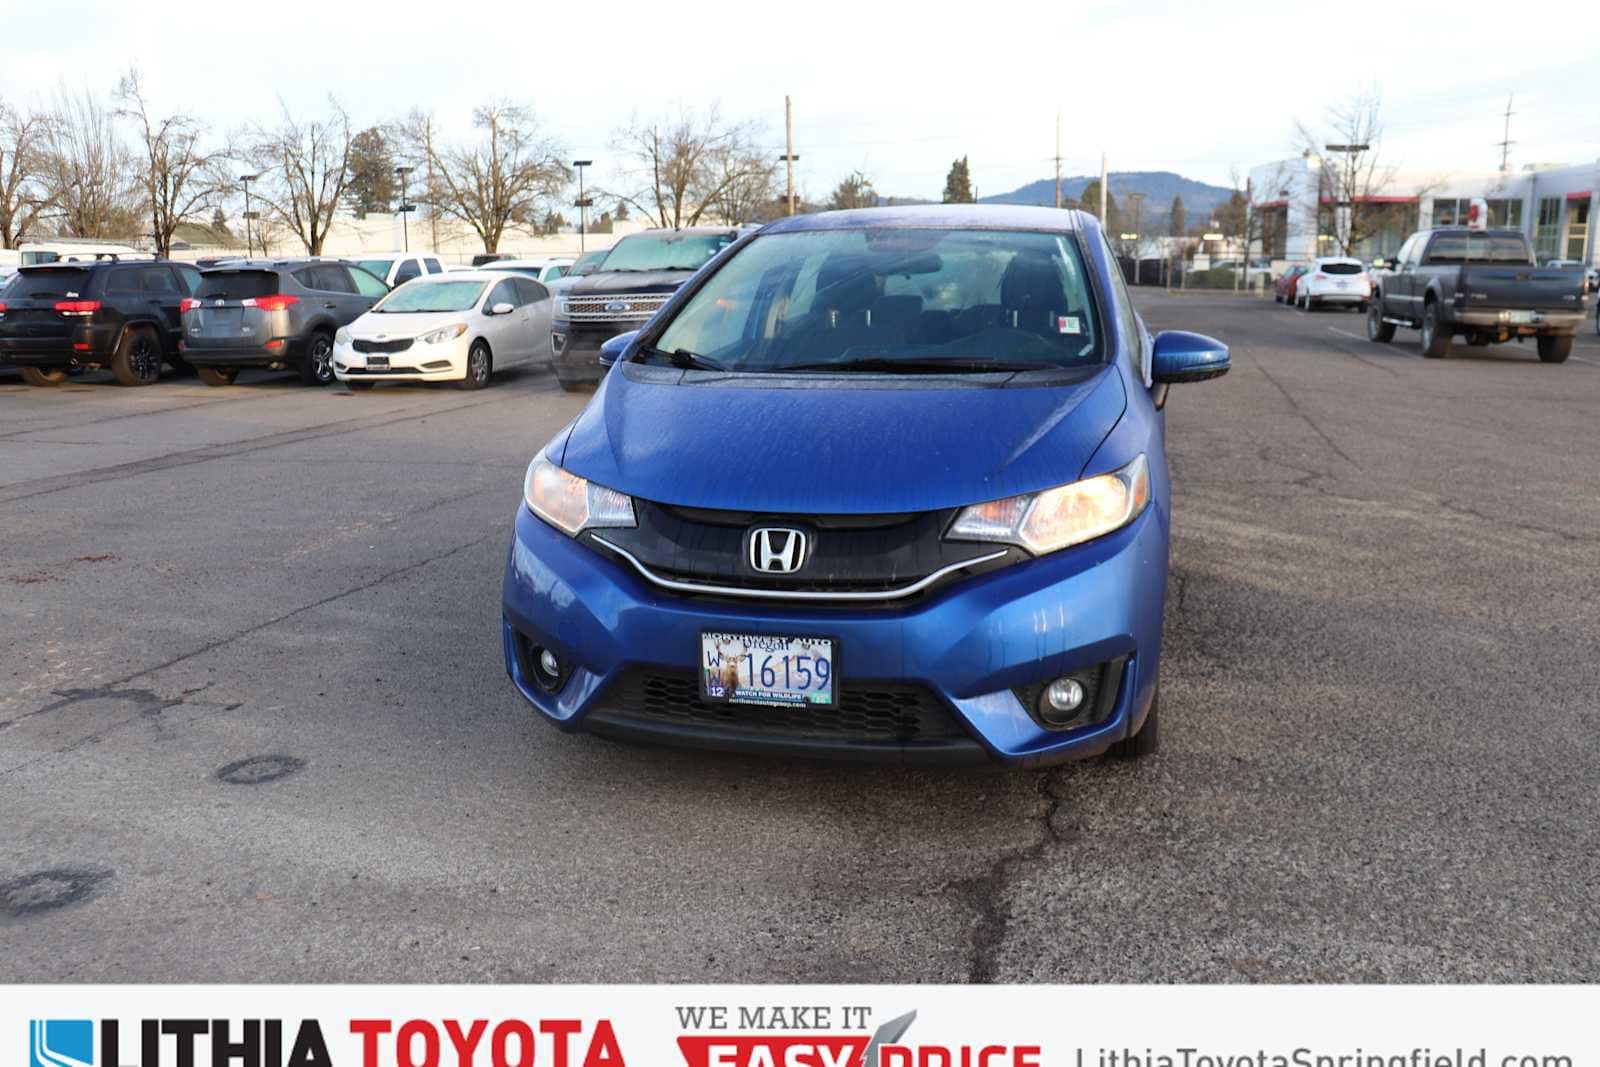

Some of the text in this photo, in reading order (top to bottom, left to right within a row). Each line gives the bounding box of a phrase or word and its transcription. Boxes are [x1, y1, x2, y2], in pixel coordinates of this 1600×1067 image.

[793, 638, 832, 646] AUTO
[746, 653, 830, 690] 16159
[711, 687, 724, 697] 12
